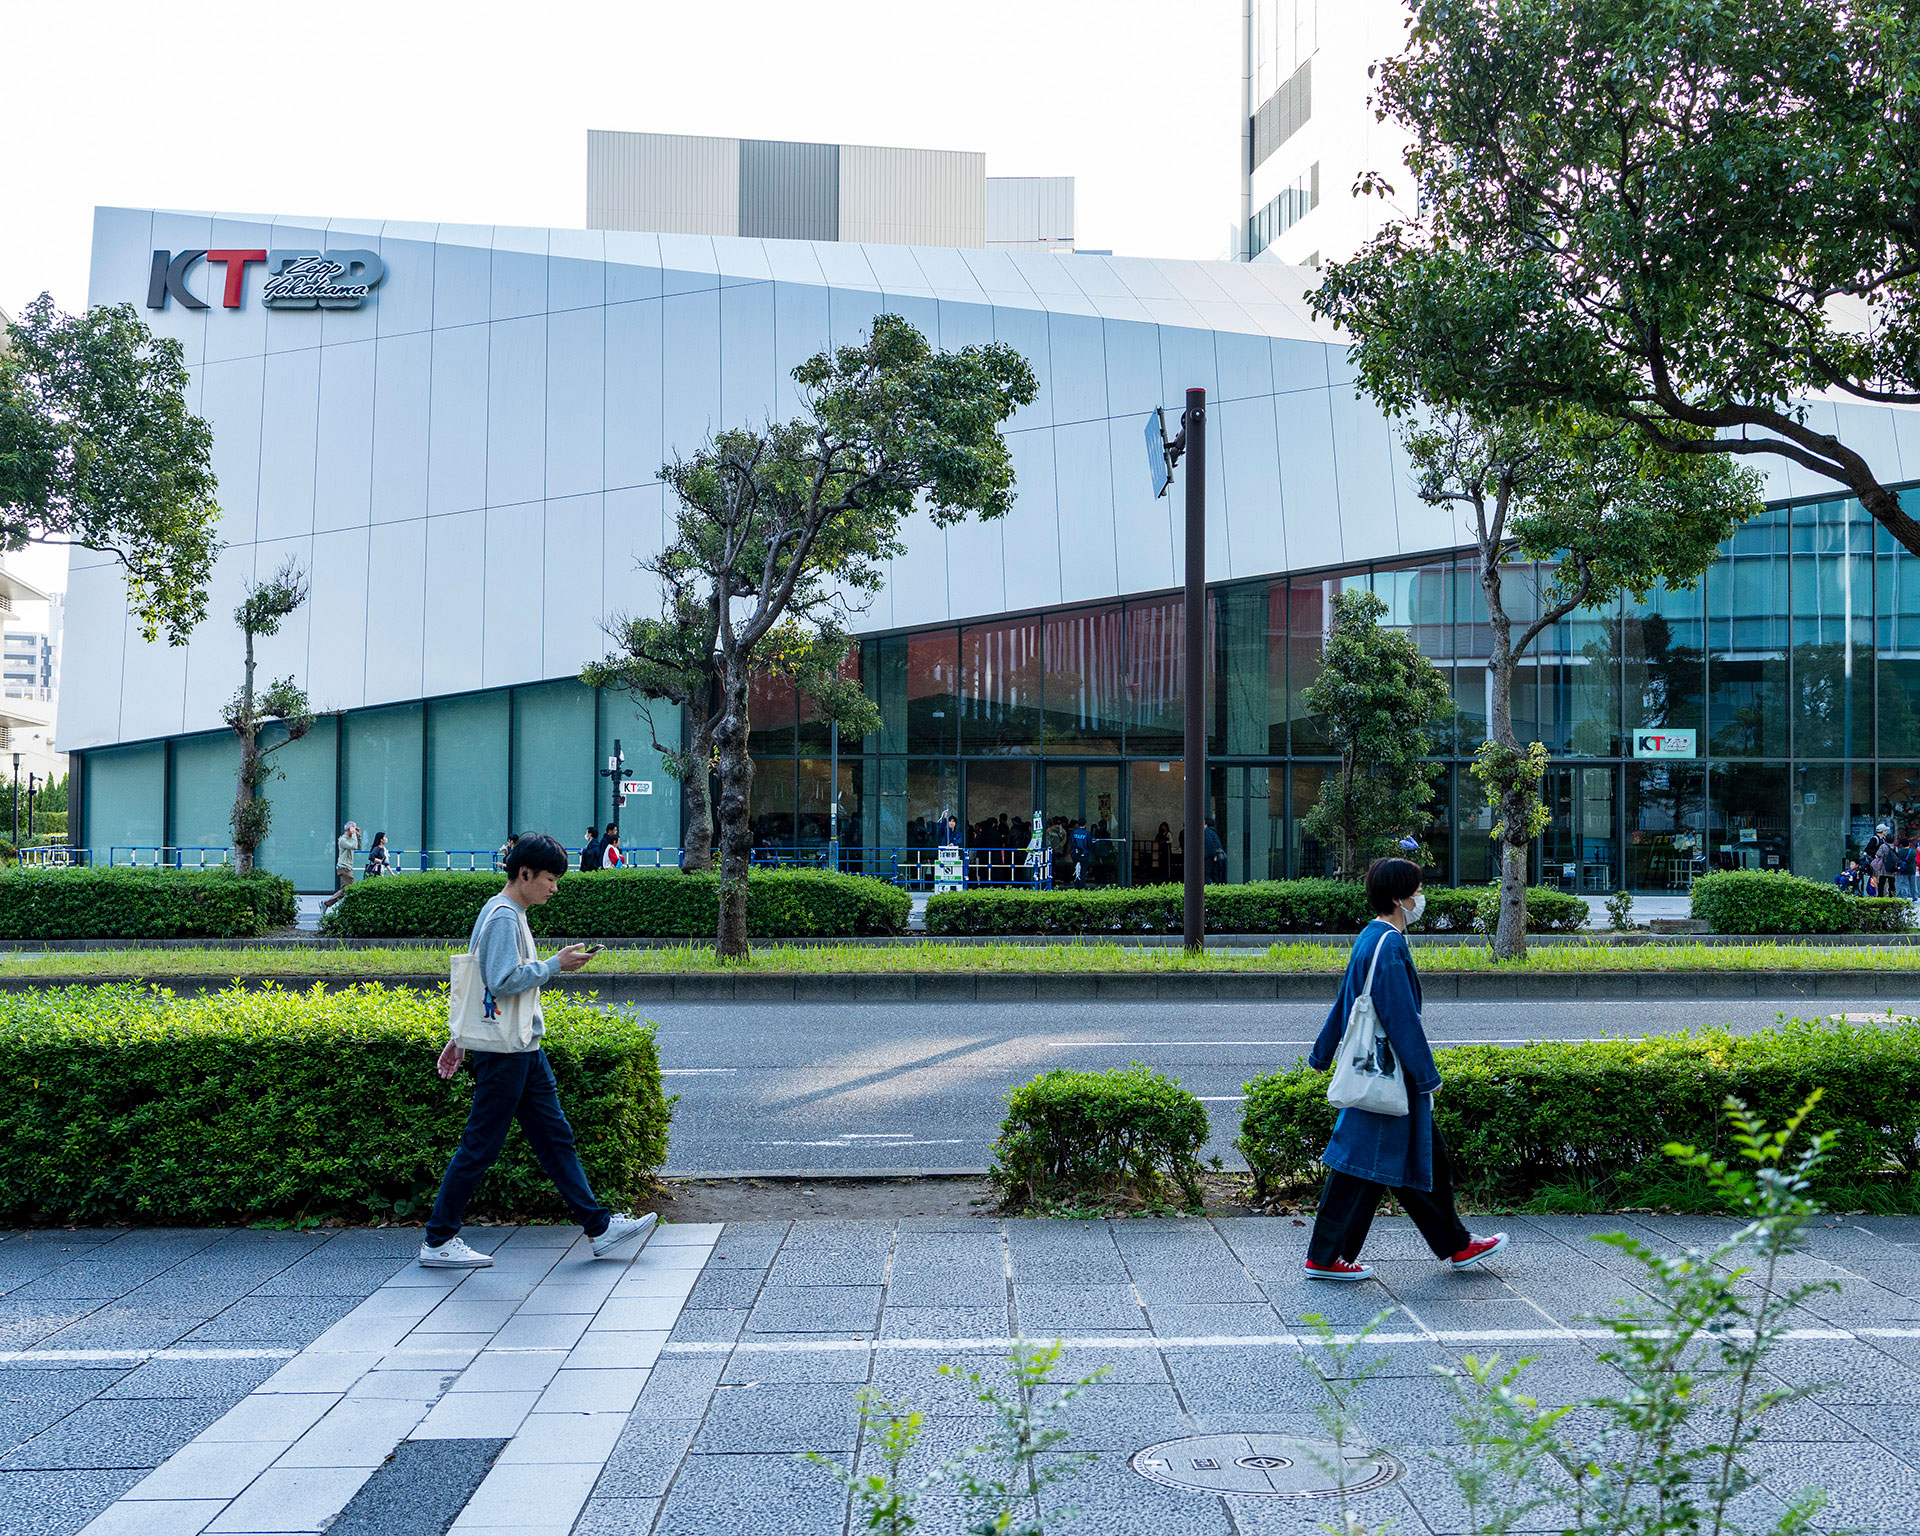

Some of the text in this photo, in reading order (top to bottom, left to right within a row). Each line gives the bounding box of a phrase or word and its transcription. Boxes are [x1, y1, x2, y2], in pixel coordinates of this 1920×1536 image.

[147, 249, 267, 309] KT
[285, 255, 346, 282] Zepp
[262, 276, 369, 301] Yokohama
[1639, 736, 1666, 751] KT
[624, 782, 637, 793] KT
